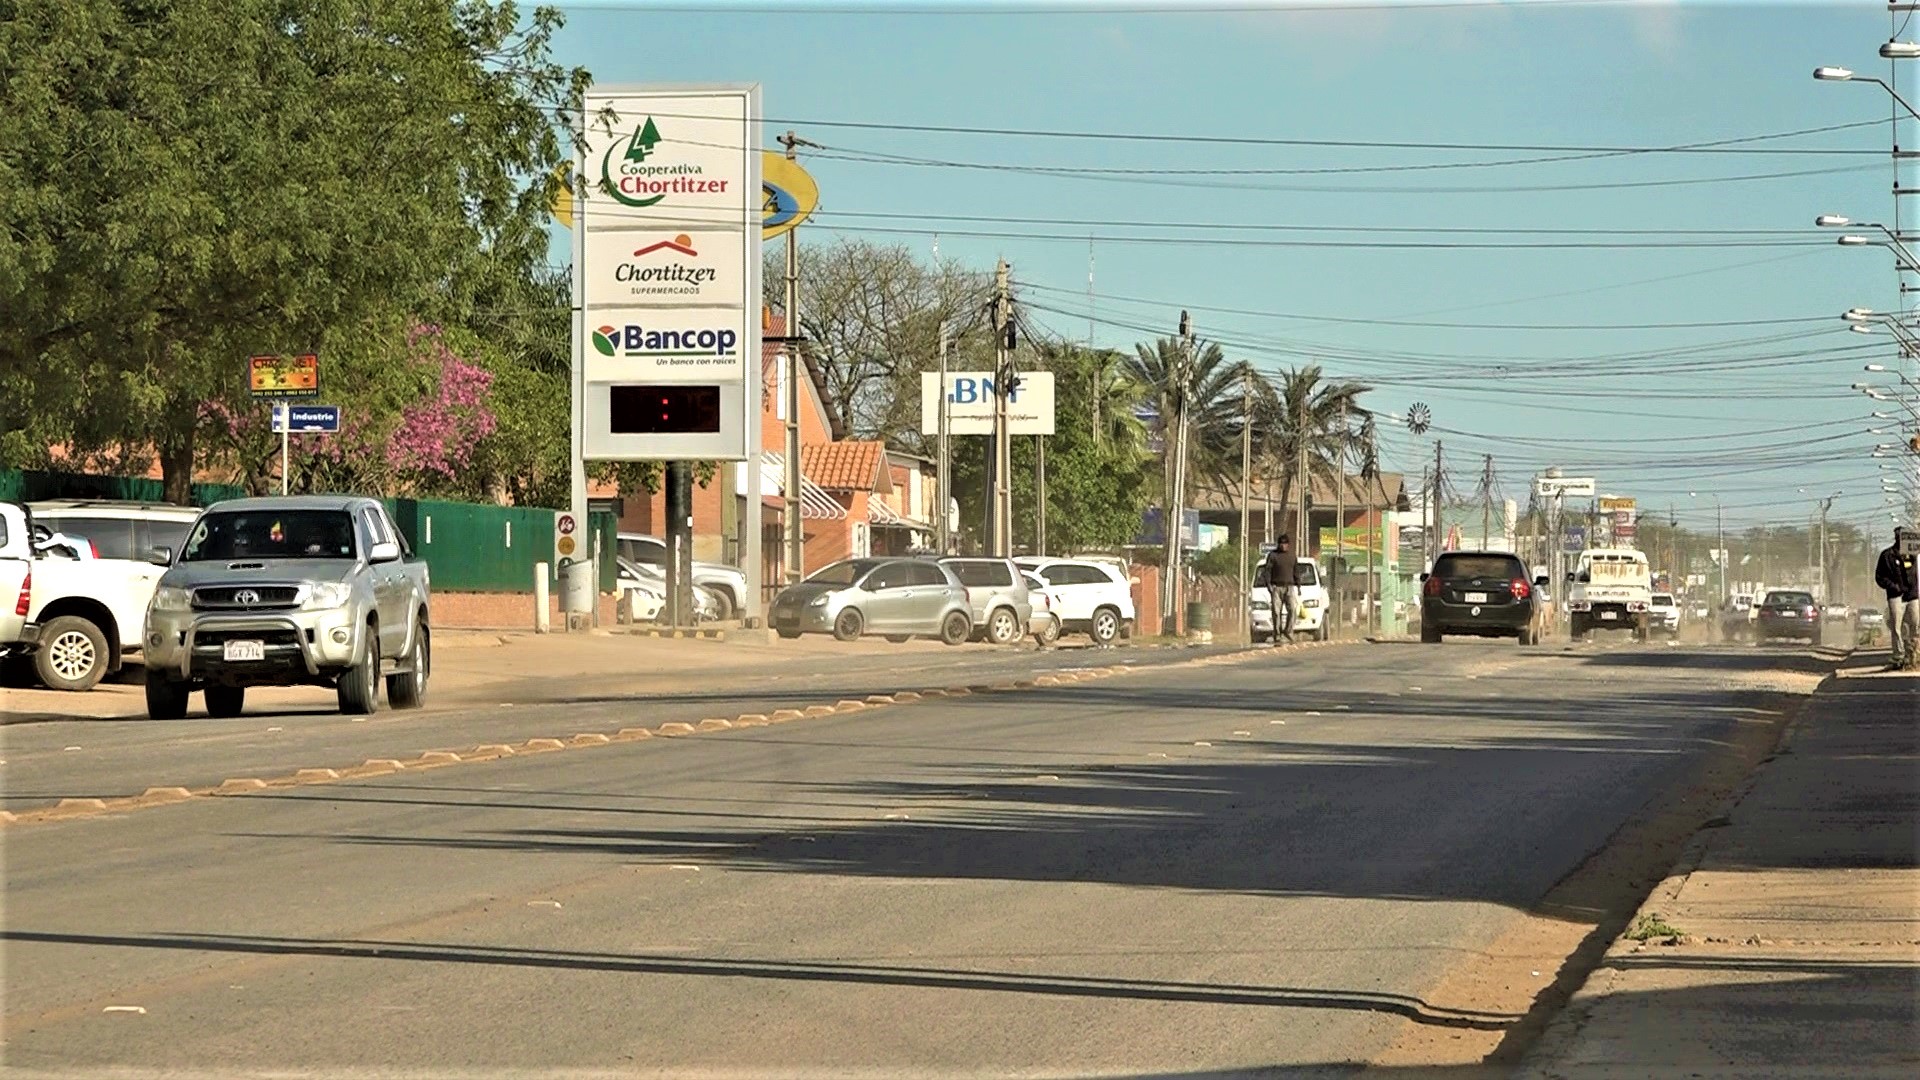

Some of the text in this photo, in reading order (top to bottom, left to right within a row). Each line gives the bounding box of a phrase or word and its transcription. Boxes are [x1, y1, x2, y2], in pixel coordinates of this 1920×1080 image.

[620, 163, 702, 177] Cooperativa
[620, 176, 728, 194] Chortitzer
[615, 262, 716, 286] Chortitzer
[631, 287, 700, 295] SUPERMERCADOS
[624, 325, 737, 356] Bancop
[656, 358, 668, 366] Un
[669, 358, 694, 366] banco
